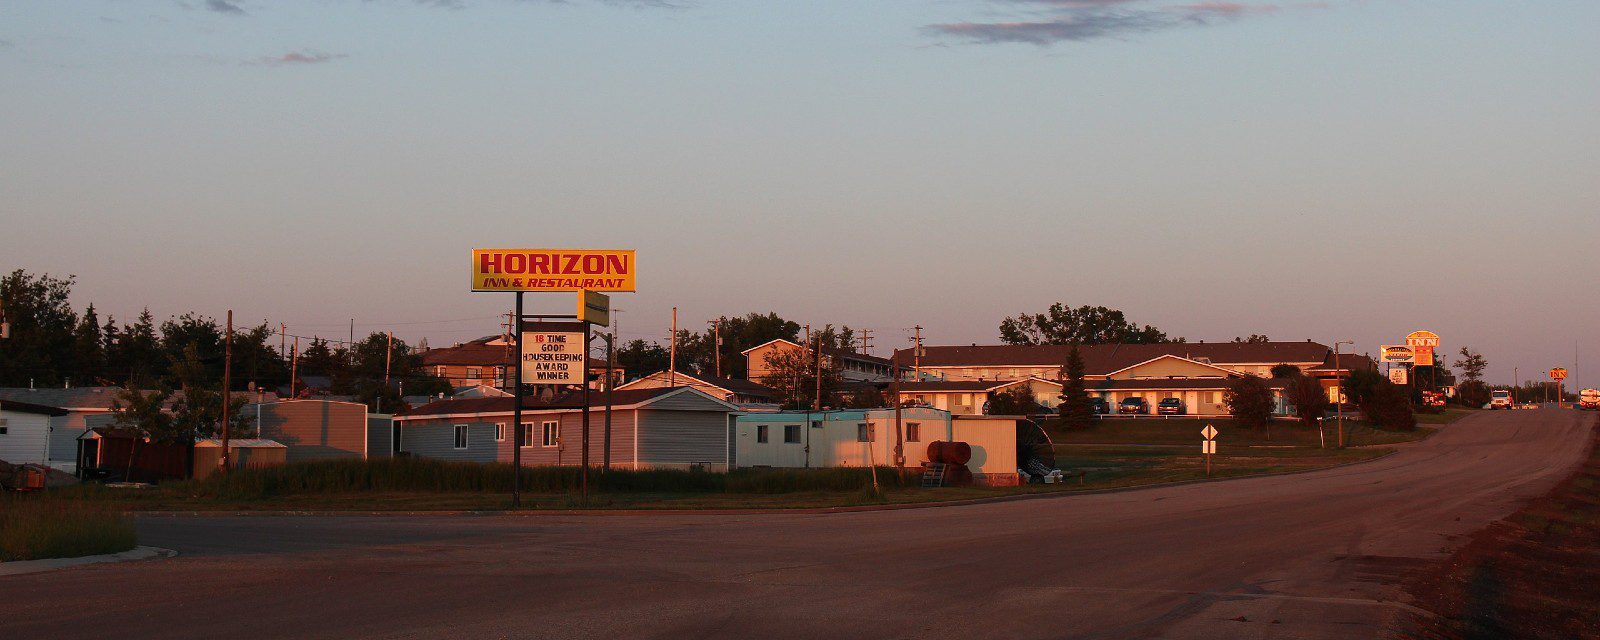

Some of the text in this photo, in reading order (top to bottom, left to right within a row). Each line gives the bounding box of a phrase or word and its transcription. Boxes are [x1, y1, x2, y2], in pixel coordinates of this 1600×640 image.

[480, 253, 628, 275] HORIZON
[483, 278, 625, 288] INN & RESTAURANT
[534, 334, 567, 343] 18 TIME
[1408, 338, 1437, 347] INN
[541, 344, 565, 352] GOOD
[523, 353, 583, 362] HOUSEKEEPING
[535, 363, 569, 371] AWARD
[536, 371, 570, 380] WINNER
